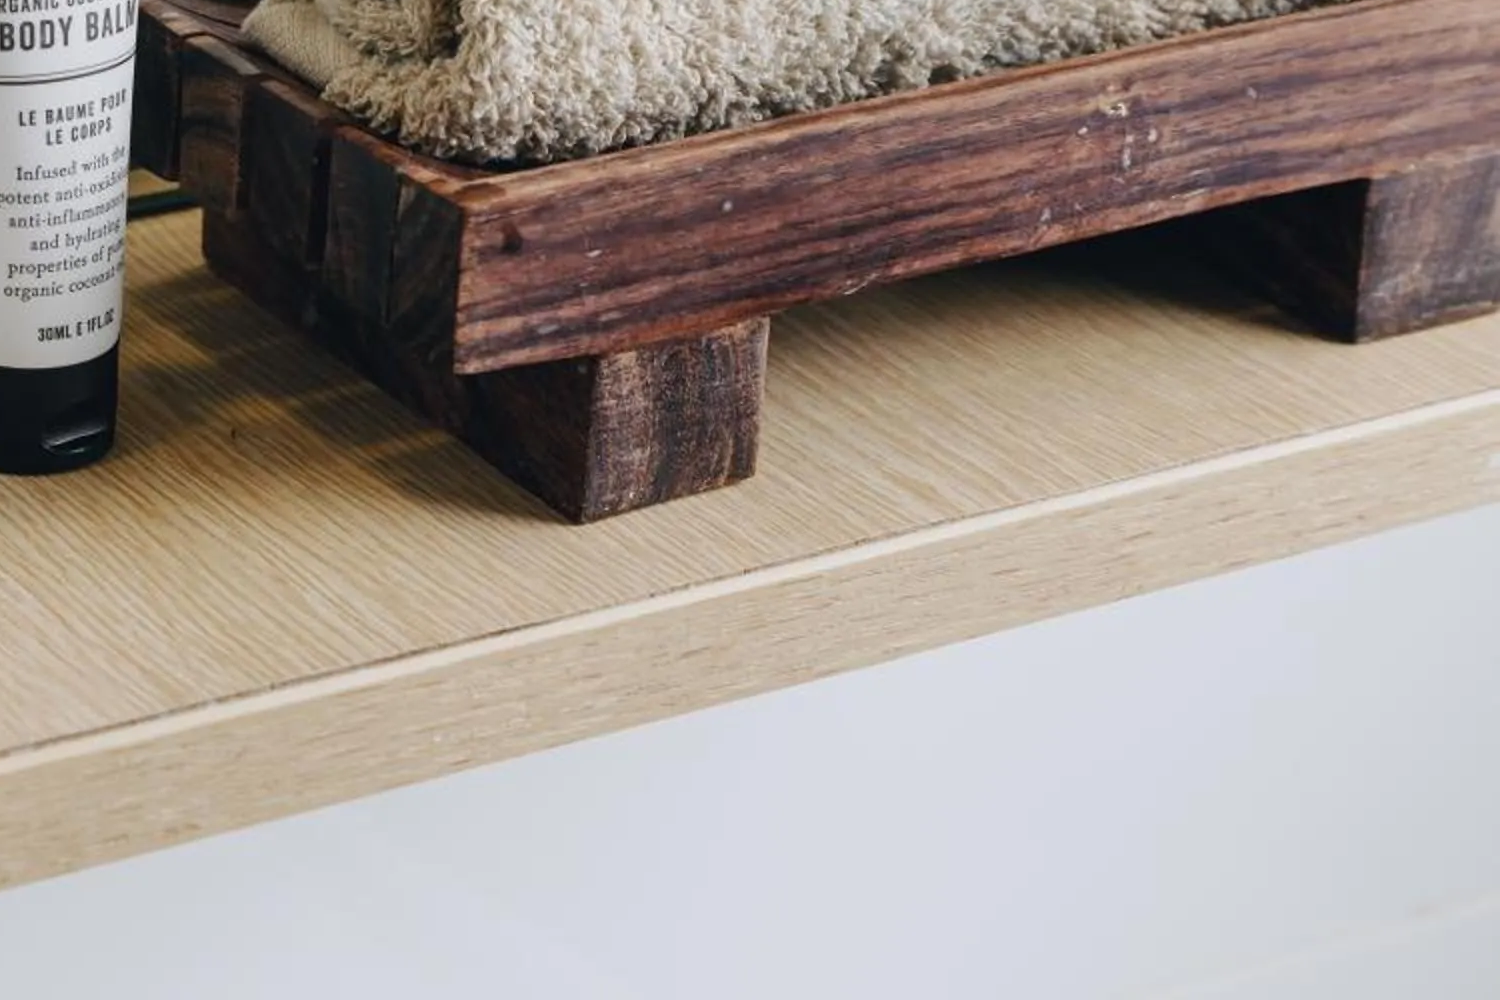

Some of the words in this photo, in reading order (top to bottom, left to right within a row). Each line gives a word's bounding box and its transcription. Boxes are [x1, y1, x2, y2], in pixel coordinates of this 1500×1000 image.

[0, 16, 73, 51] BODY
[19, 110, 37, 127] LE
[45, 101, 95, 126] BAUME
[46, 128, 63, 146] LE
[70, 116, 112, 143] CORPS
[16, 160, 77, 181] Infused
[81, 153, 110, 172] with
[30, 233, 59, 251] and
[7, 255, 87, 279] properties
[91, 246, 105, 262] of
[3, 281, 64, 303] organic
[37, 325, 72, 342] 30ML
